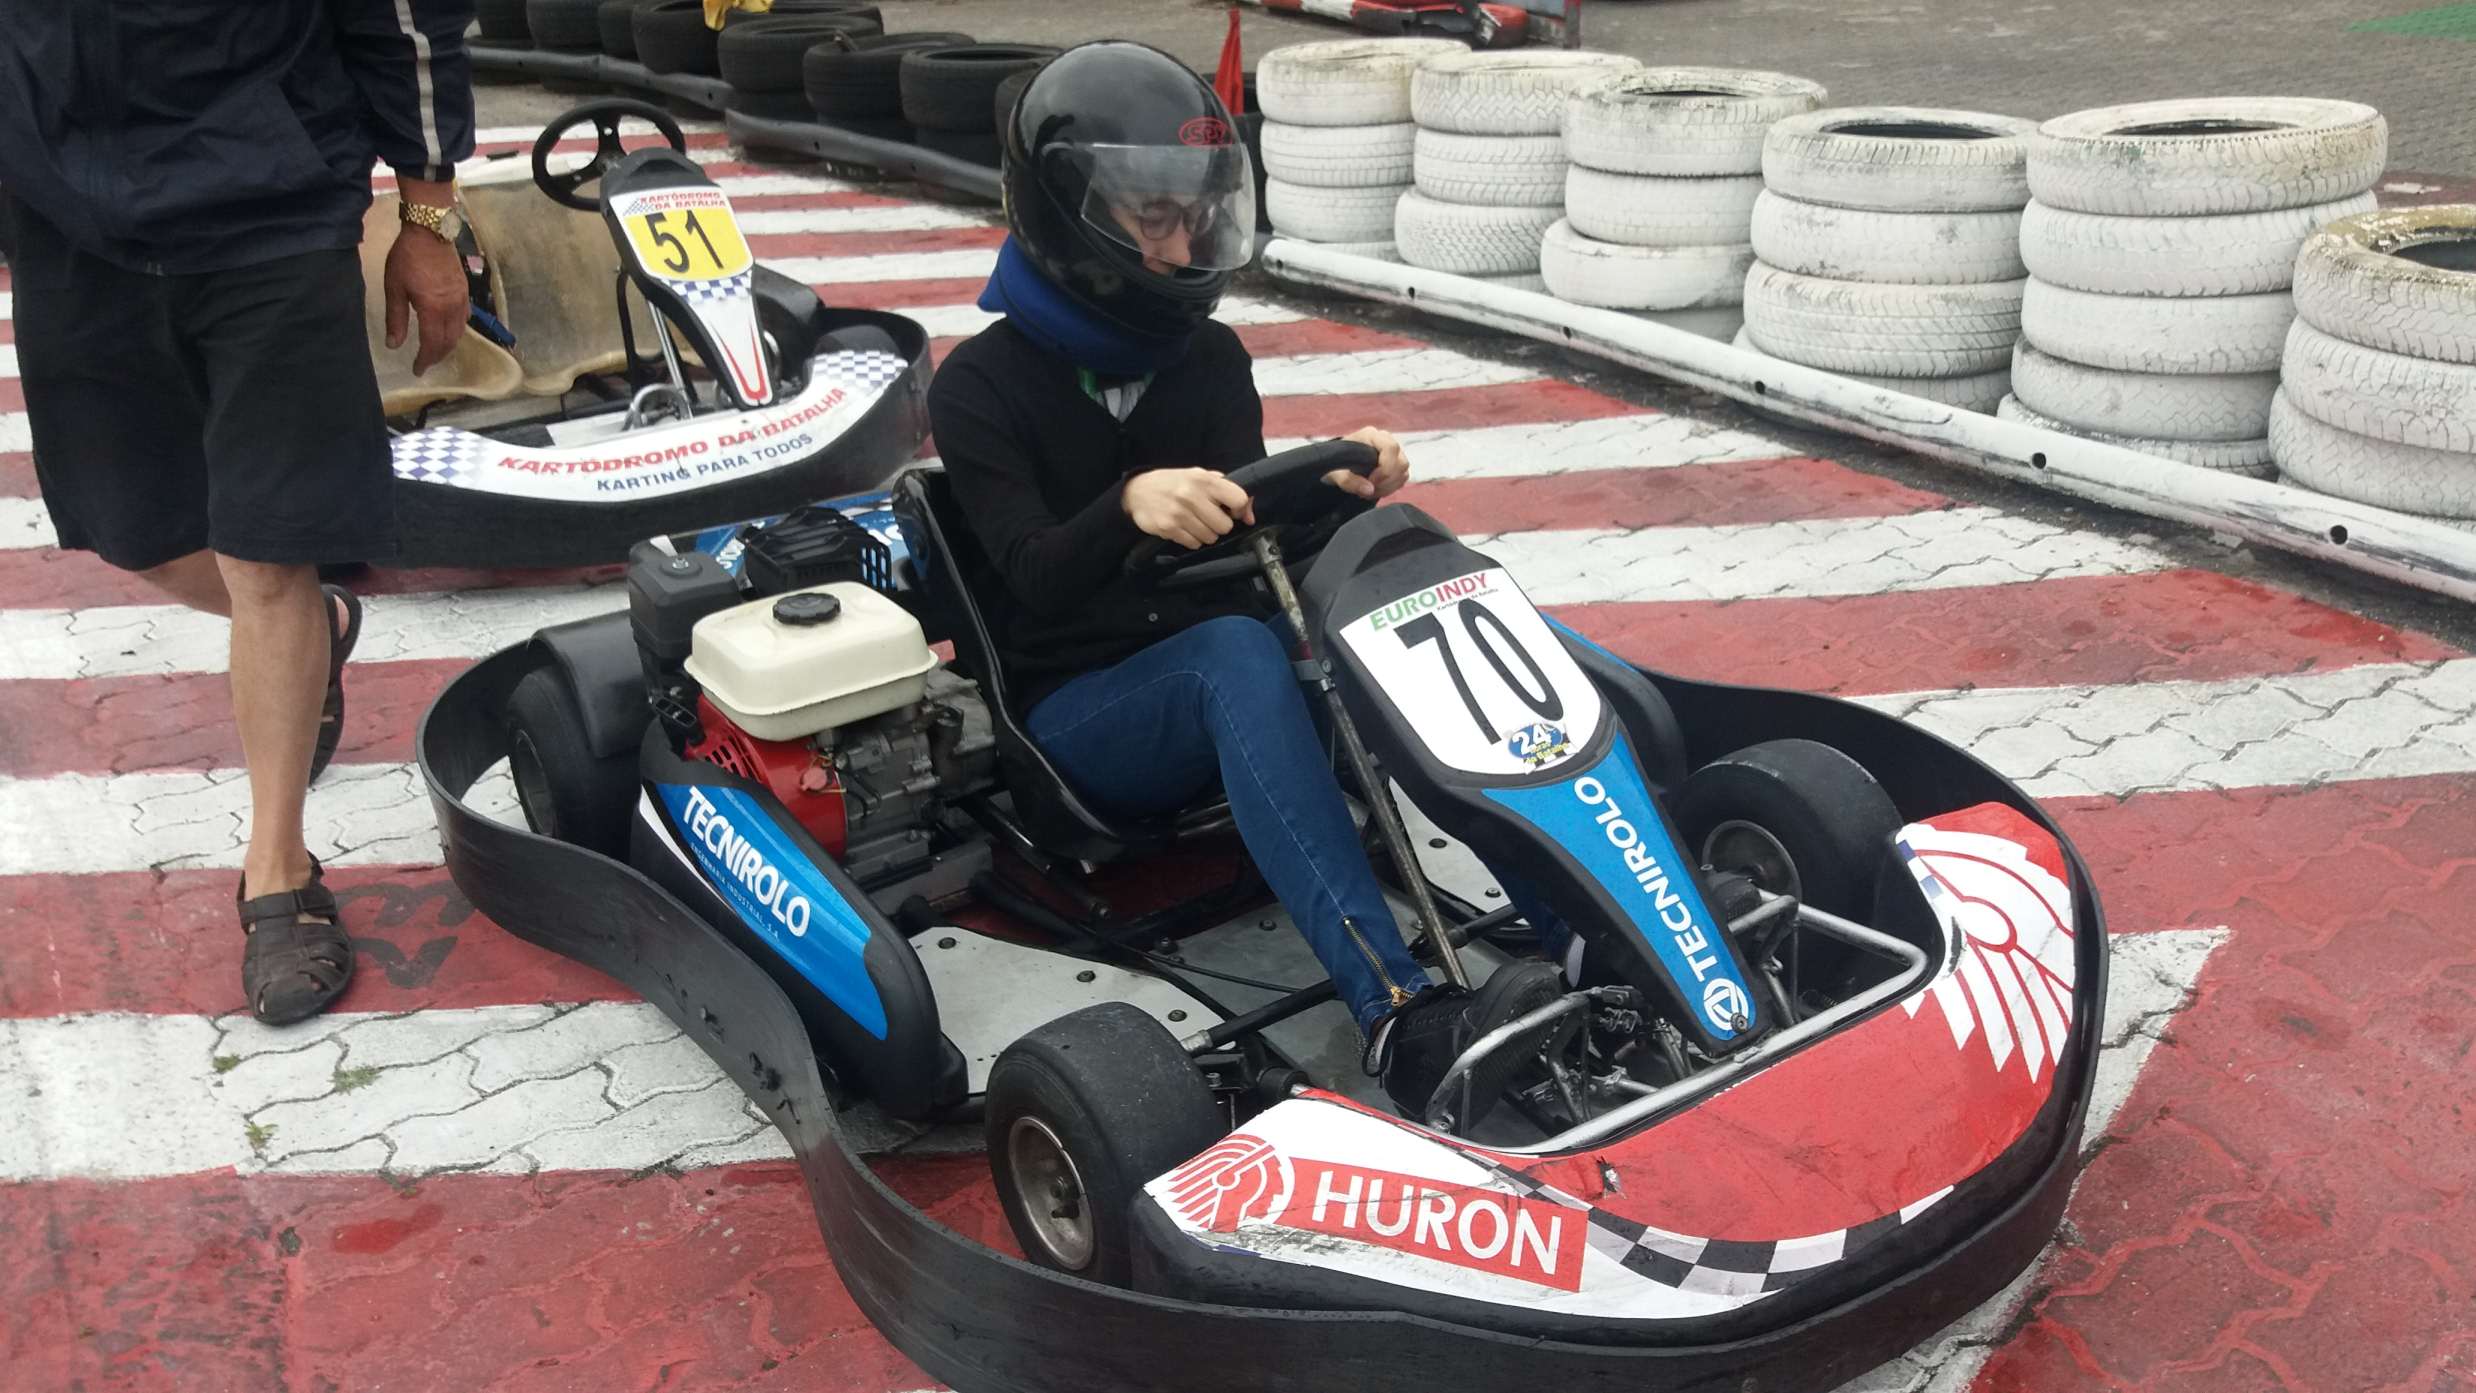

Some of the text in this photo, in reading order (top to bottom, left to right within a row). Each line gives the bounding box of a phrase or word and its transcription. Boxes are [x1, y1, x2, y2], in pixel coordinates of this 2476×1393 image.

[645, 209, 724, 273] 51
[718, 431, 753, 448] DA
[760, 386, 848, 440] BATALHA
[597, 433, 813, 492] KARTING PARA TODOS
[1369, 573, 1487, 632] EUROINDY
[1393, 598, 1564, 745] 70
[682, 785, 811, 937] TECNIROLO
[1574, 776, 1718, 982] TECNIROLO
[1312, 1169, 1562, 1277] HURON
